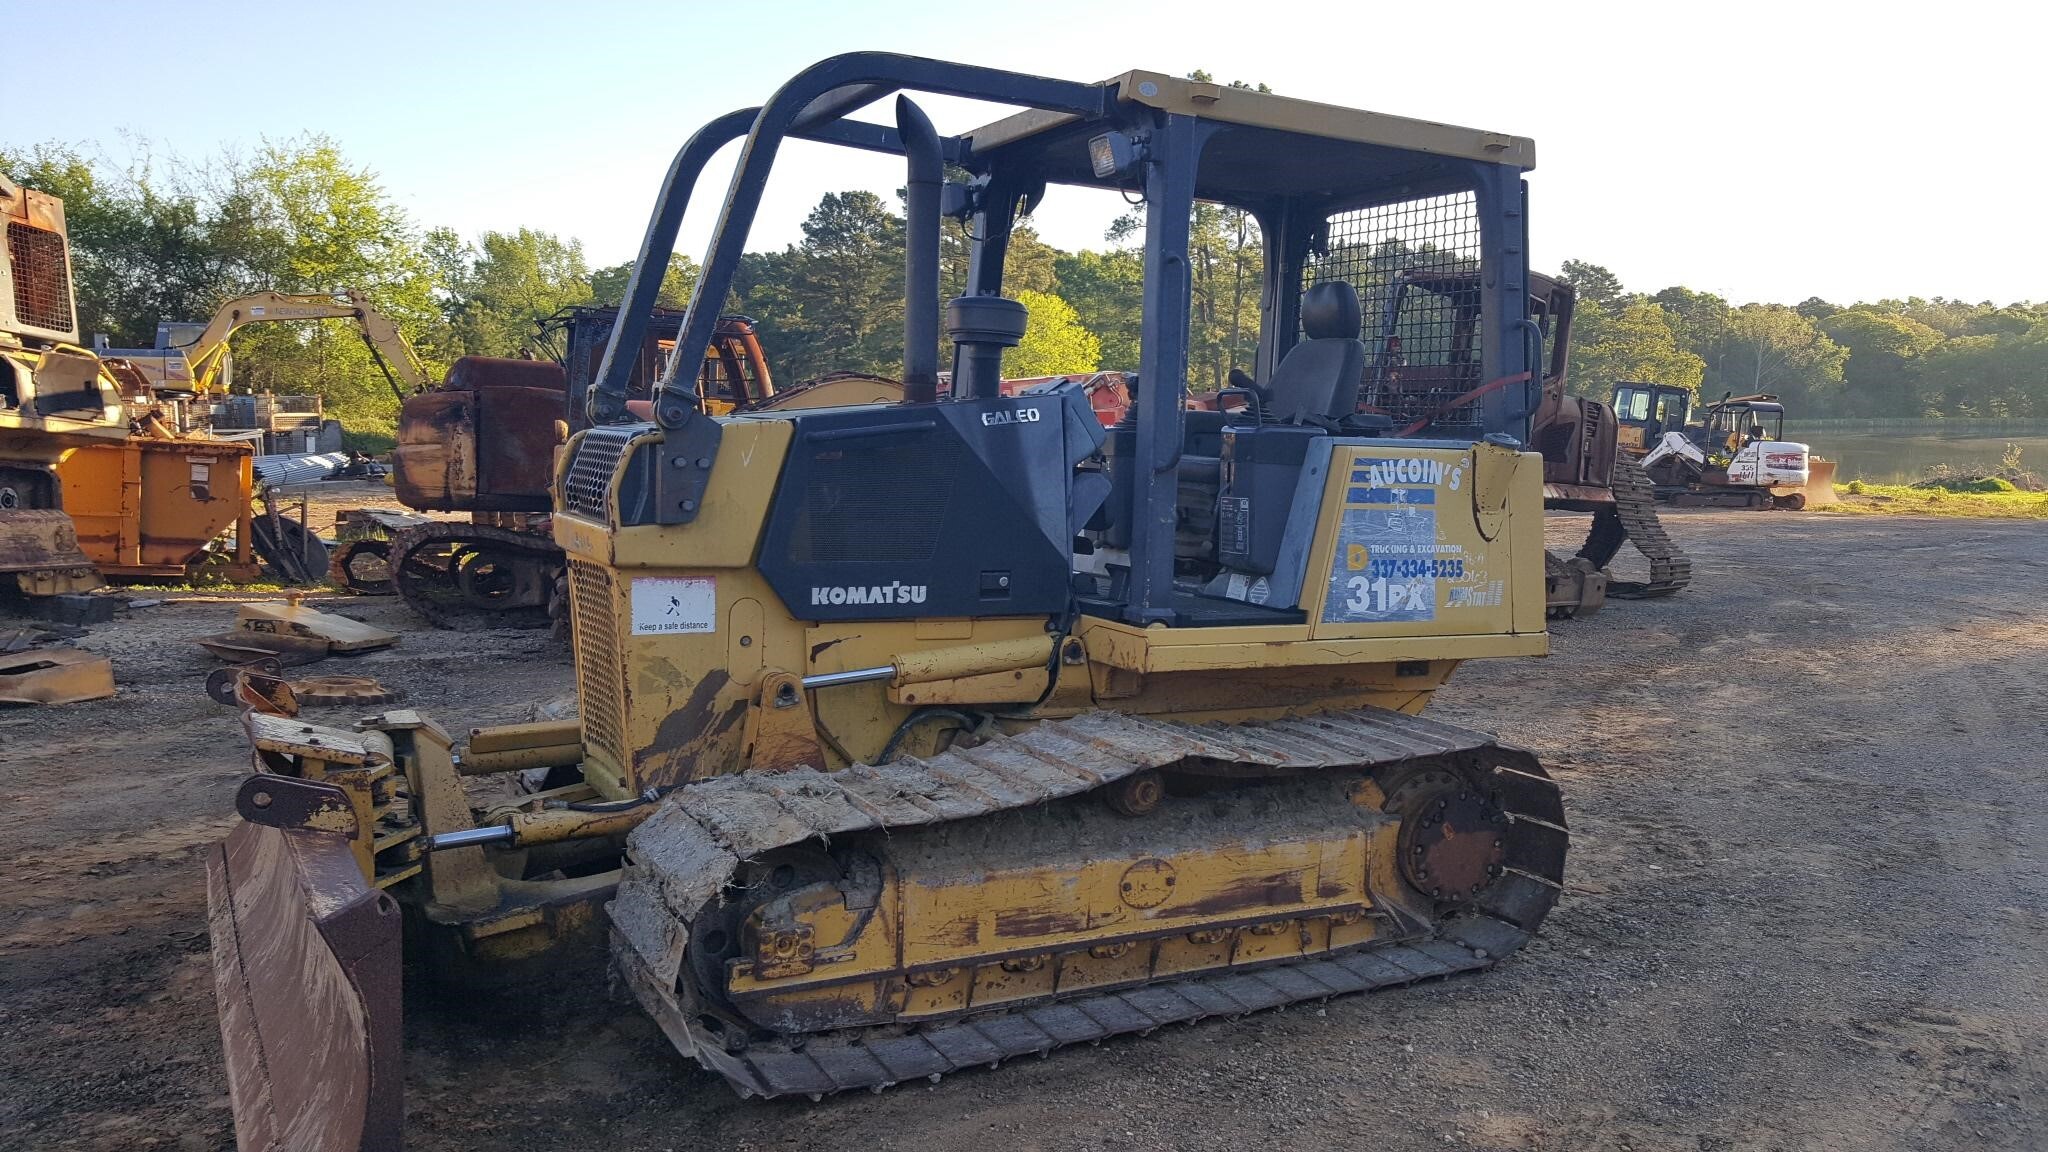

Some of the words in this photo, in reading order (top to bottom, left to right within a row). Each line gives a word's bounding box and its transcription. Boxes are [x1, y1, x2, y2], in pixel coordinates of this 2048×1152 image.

[981, 408, 1040, 426] GALEO
[1368, 458, 1462, 490] AUCOIN'S
[1409, 545, 1415, 554] &
[1417, 544, 1462, 554] EXCAVATION
[1371, 559, 1464, 578] 337-334-5235
[811, 581, 927, 605] KOMATSU
[639, 622, 657, 632] Keep
[664, 621, 679, 630] safe
[680, 621, 709, 630] distance
